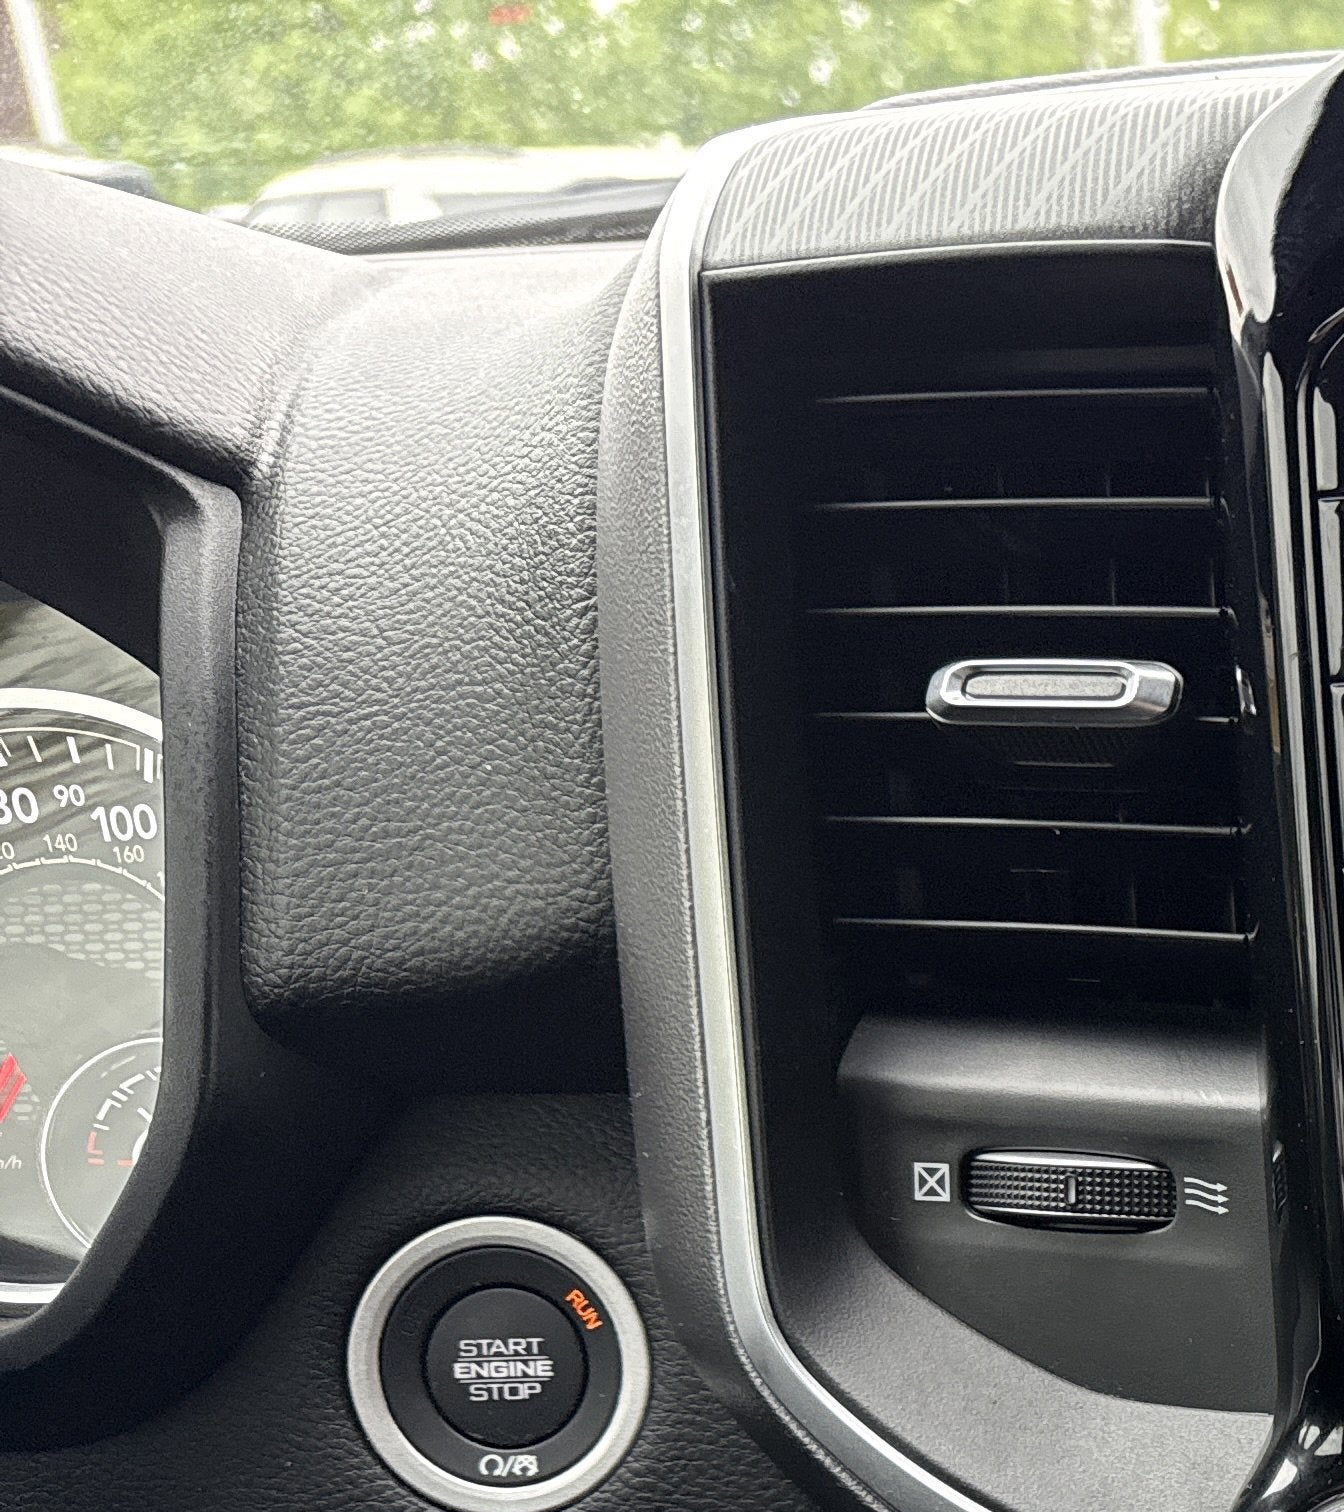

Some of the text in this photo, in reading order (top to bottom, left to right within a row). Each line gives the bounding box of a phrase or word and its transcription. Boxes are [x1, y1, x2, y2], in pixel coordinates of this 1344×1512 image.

[53, 784, 85, 807] 90
[90, 803, 157, 842] 100
[42, 833, 78, 852] 140
[113, 845, 145, 863] 160
[565, 1288, 603, 1331] RUN
[459, 1338, 545, 1356] START
[453, 1361, 554, 1378] ENGINE
[469, 1383, 542, 1401] STOP
